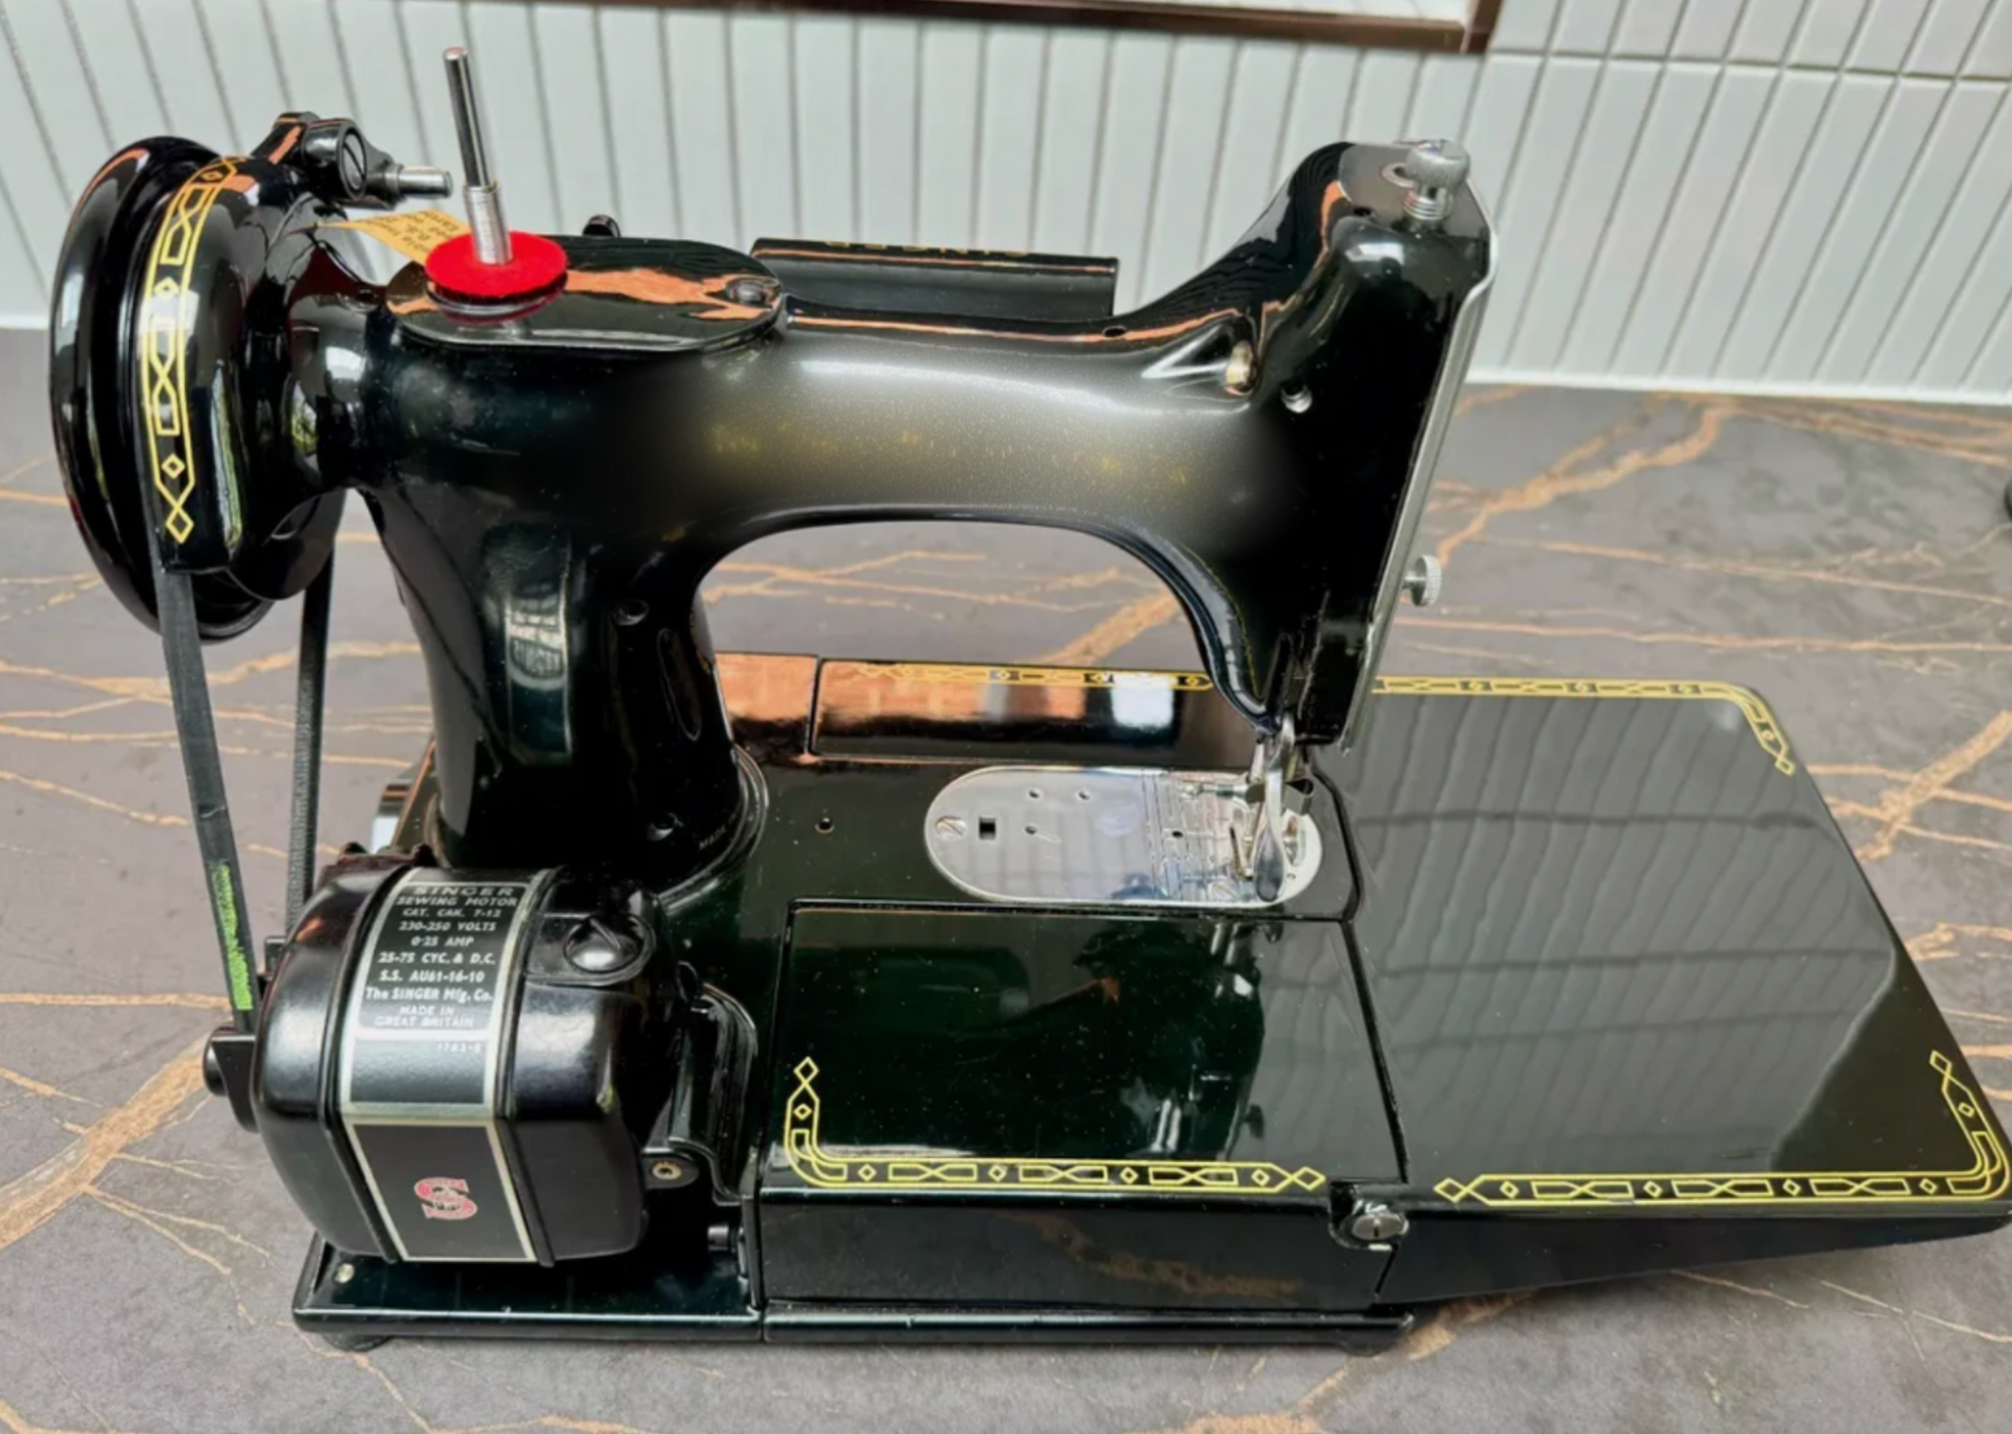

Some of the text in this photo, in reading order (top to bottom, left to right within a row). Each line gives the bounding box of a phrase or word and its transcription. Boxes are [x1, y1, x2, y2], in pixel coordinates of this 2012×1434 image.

[412, 887, 514, 896] SINGER
[396, 896, 518, 906] SEWING MOTOR
[402, 908, 430, 917] CAT.
[473, 908, 502, 918] 7-12
[398, 921, 497, 931] 230-250 VOLTS
[444, 936, 475, 947] AMP
[377, 952, 416, 964] 25-75
[421, 953, 450, 964] CYC.
[470, 954, 496, 965] D.C.
[379, 969, 485, 983] S.S. AU61-16-10
[365, 986, 389, 1000] The
[392, 986, 440, 1000] SINGER
[474, 988, 493, 1001] Co.
[399, 1005, 456, 1016] MADE IN
[420, 1016, 476, 1029] BRITAIN
